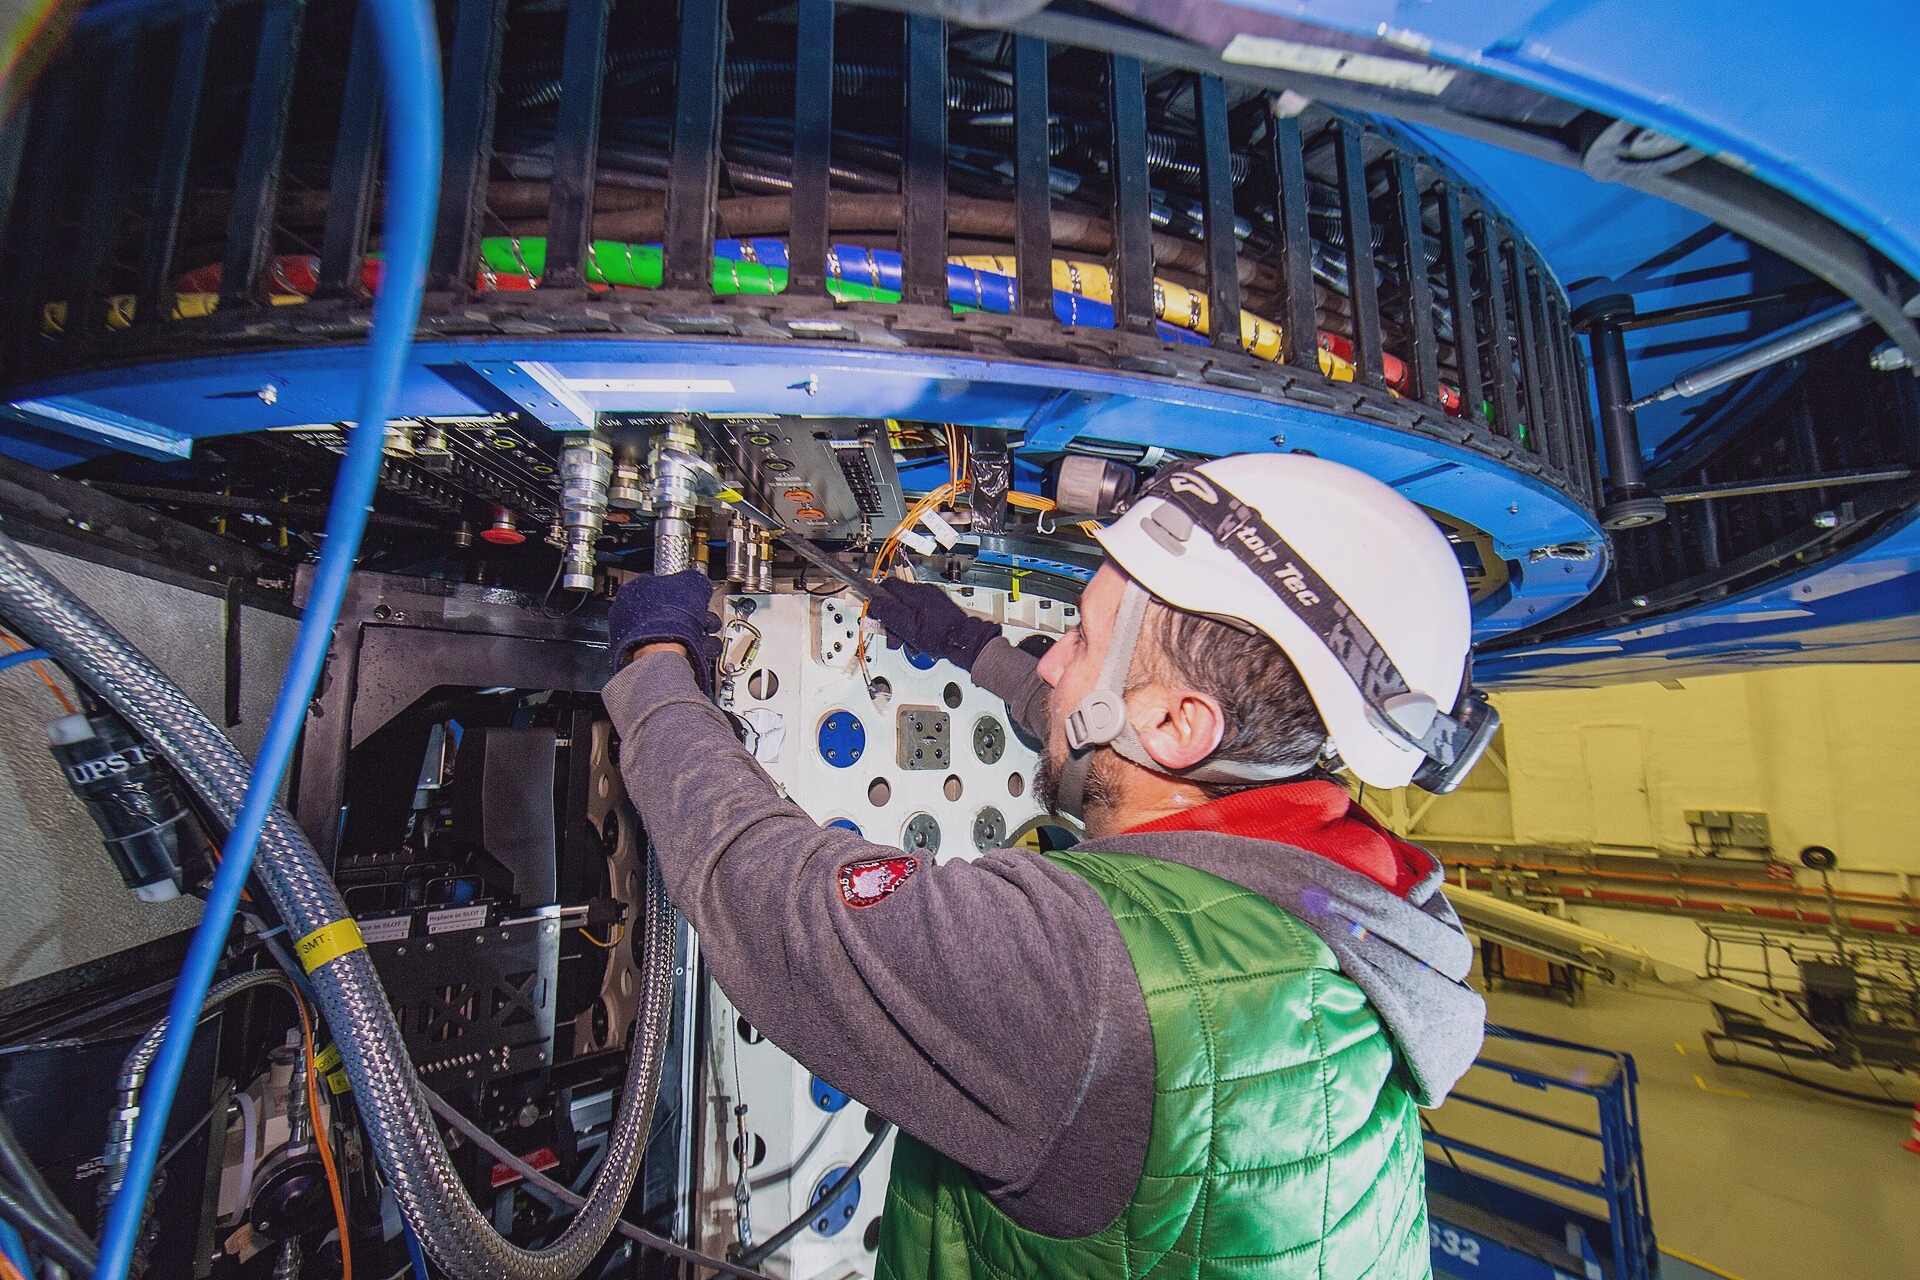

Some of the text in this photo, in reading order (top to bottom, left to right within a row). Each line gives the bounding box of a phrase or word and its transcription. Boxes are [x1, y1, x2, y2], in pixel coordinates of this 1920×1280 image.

[1236, 525, 1321, 607] ton Tec
[68, 752, 131, 785] UPS
[382, 921, 401, 929] SLOT
[429, 912, 454, 922] Replace
[463, 910, 480, 918] SLOT
